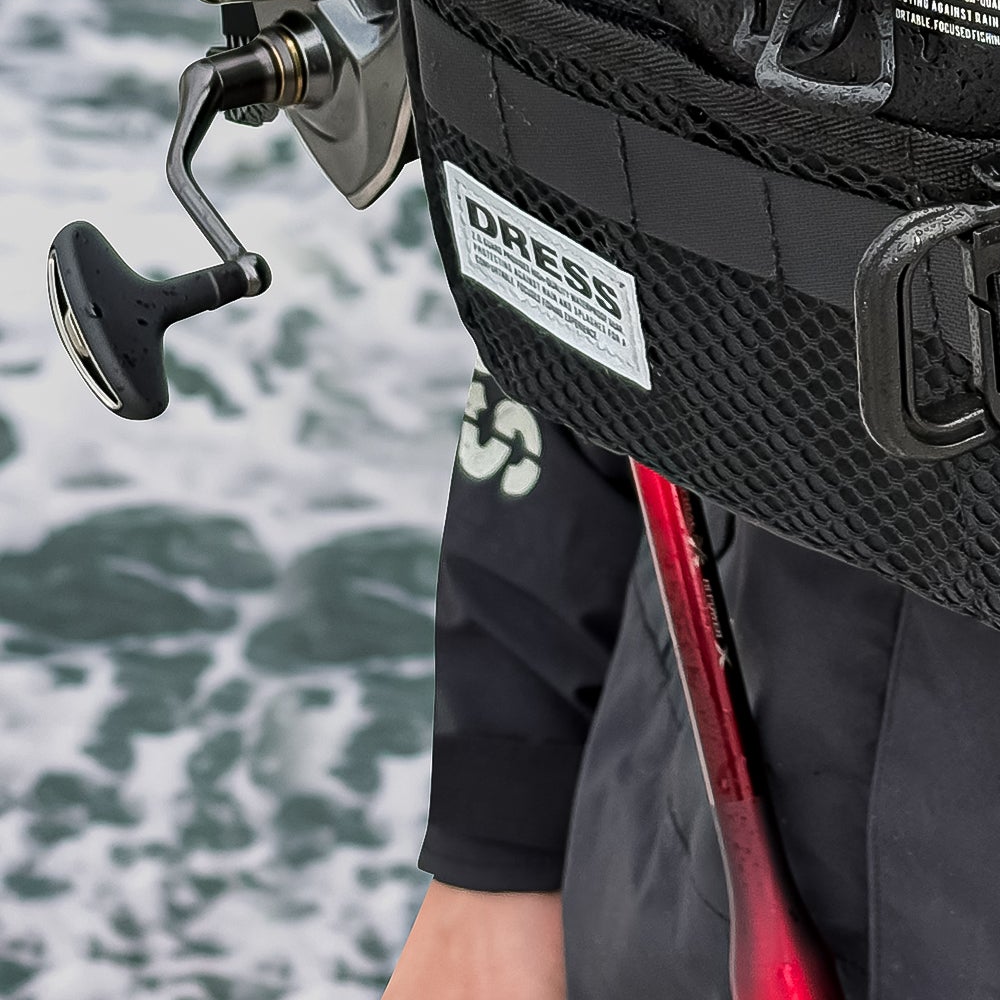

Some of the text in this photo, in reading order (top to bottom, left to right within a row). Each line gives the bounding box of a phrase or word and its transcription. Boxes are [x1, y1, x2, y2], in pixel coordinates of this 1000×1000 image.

[931, 0, 972, 22] AGAINST
[974, 11, 999, 29] RAIN
[464, 195, 622, 321] DRESS
